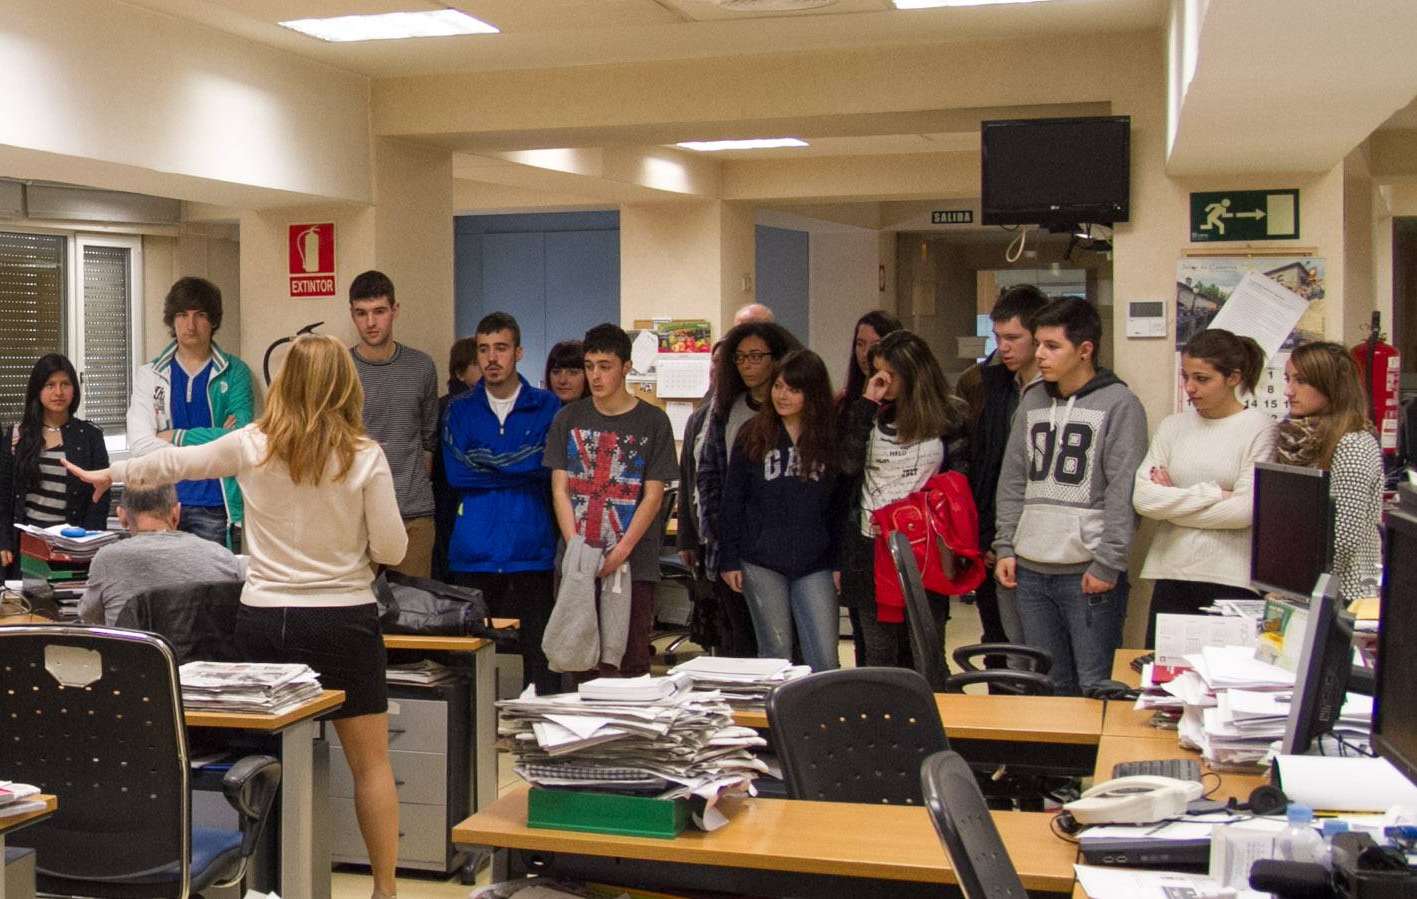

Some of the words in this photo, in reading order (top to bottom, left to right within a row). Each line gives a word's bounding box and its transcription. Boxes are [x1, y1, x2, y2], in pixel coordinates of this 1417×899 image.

[934, 211, 971, 222] SALIDA
[291, 279, 334, 293] EXTINTOR
[1267, 385, 1274, 394] 8
[1264, 400, 1277, 408] 15
[1029, 421, 1094, 485] 08
